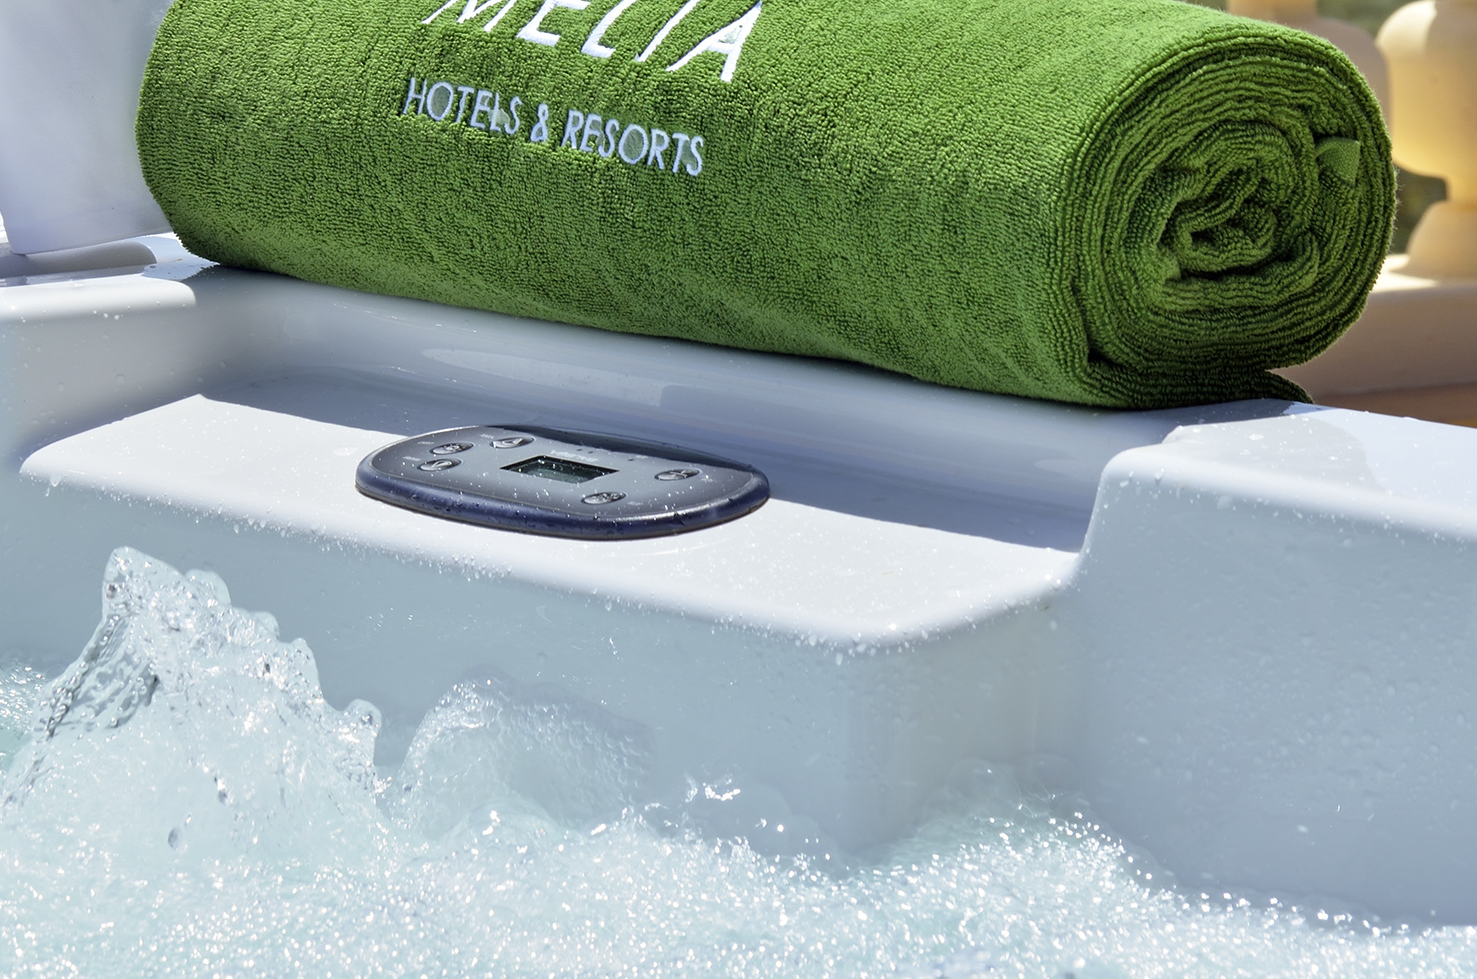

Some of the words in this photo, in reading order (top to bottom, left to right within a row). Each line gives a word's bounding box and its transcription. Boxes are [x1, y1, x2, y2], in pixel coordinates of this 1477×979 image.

[402, 76, 524, 135] HOTELS
[529, 102, 549, 143] &
[561, 109, 705, 177] RESORTS
